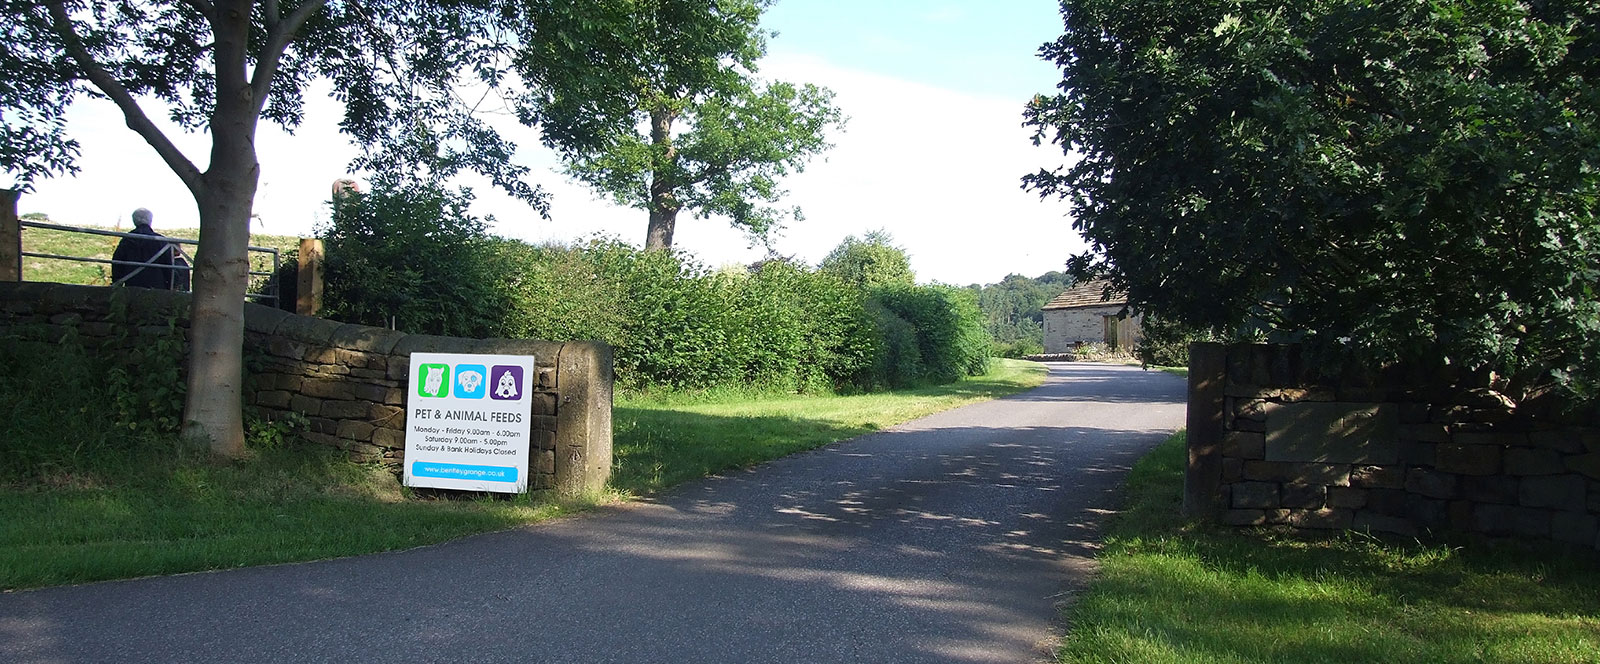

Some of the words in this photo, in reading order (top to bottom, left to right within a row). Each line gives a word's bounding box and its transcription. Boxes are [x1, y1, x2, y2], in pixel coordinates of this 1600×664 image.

[415, 408, 432, 419] PET
[434, 410, 442, 420] &
[444, 410, 488, 422] ANIMAL
[490, 412, 522, 423] FEEDS
[414, 426, 440, 434] Monday
[446, 428, 466, 436] Friday
[425, 436, 453, 444] Saturday
[416, 444, 440, 452] Sunday
[464, 447, 492, 455] Holidays
